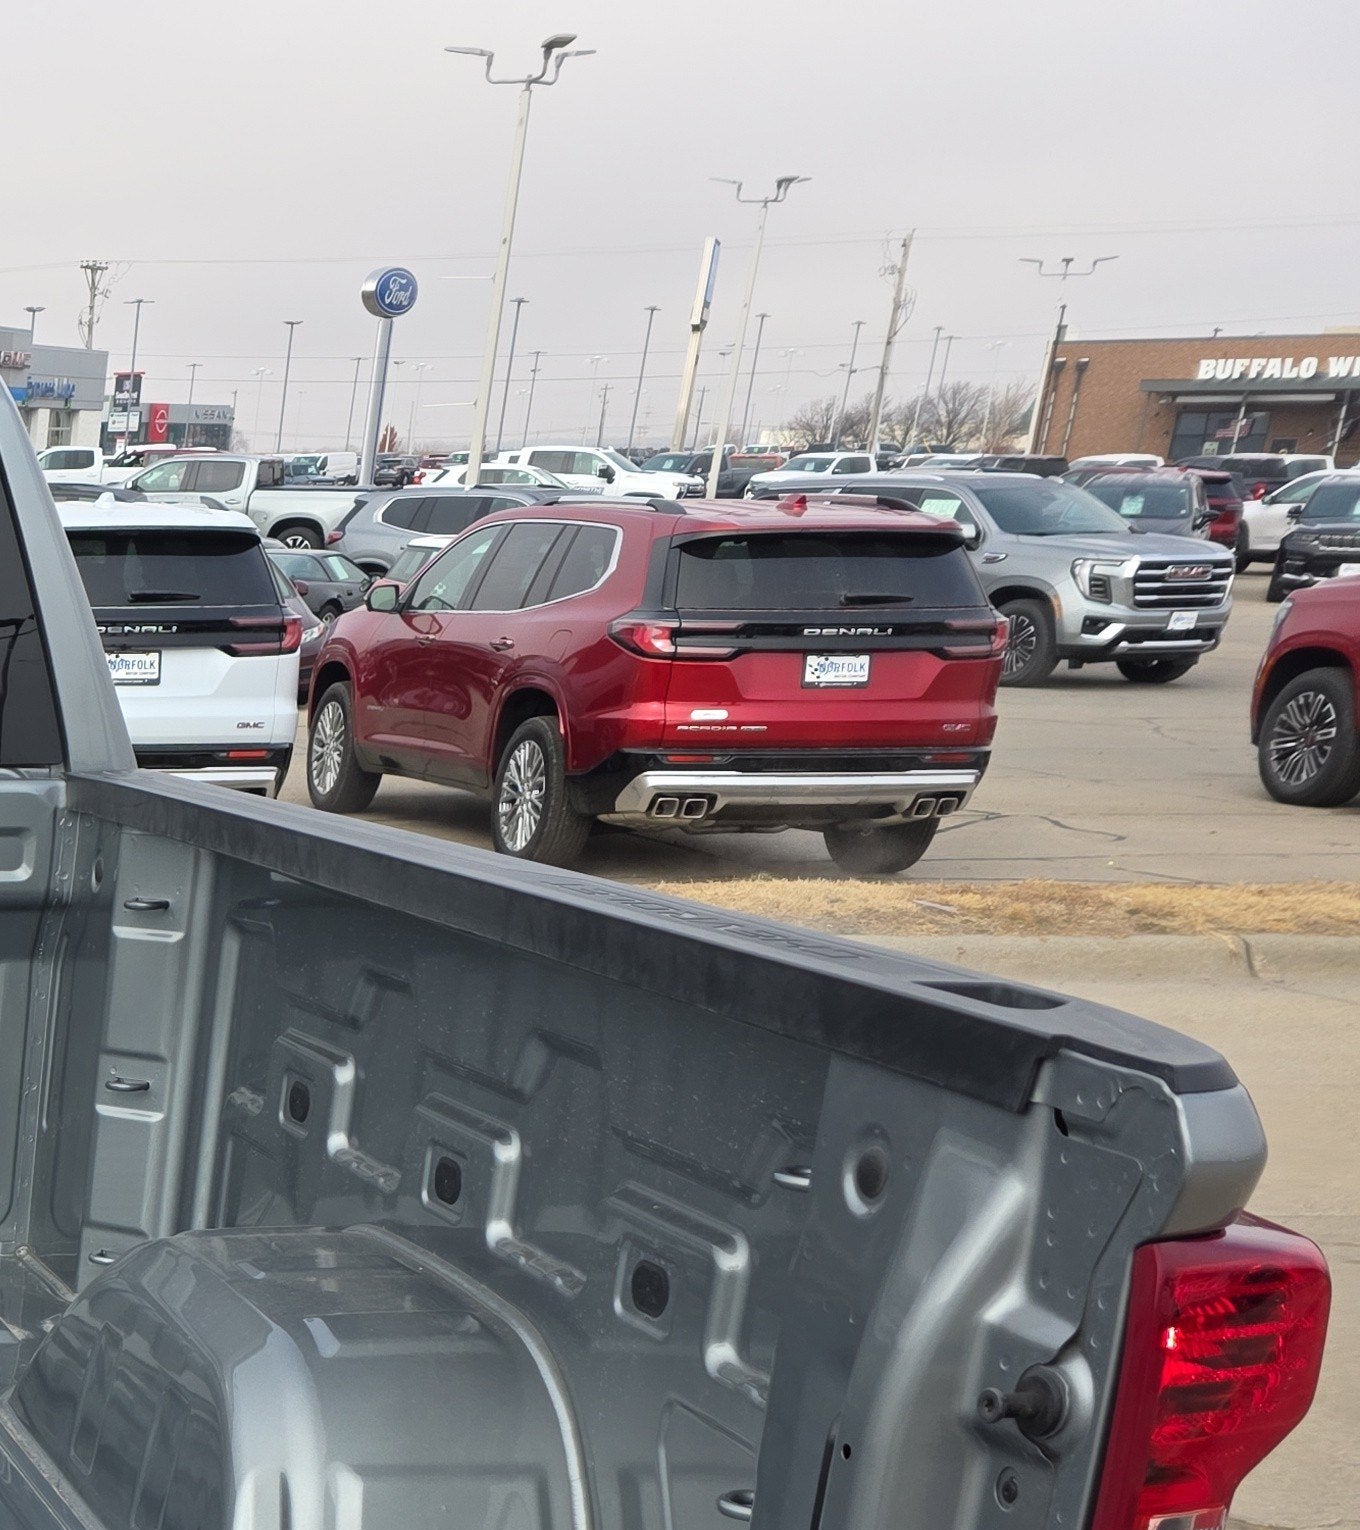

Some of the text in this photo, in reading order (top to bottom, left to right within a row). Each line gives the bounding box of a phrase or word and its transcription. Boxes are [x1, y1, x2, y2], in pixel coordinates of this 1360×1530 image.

[384, 276, 413, 306] Ford
[1197, 356, 1319, 380] BUFFALO
[194, 409, 228, 420] NISSAN
[803, 627, 893, 636] DENALI
[236, 721, 266, 729] GMC
